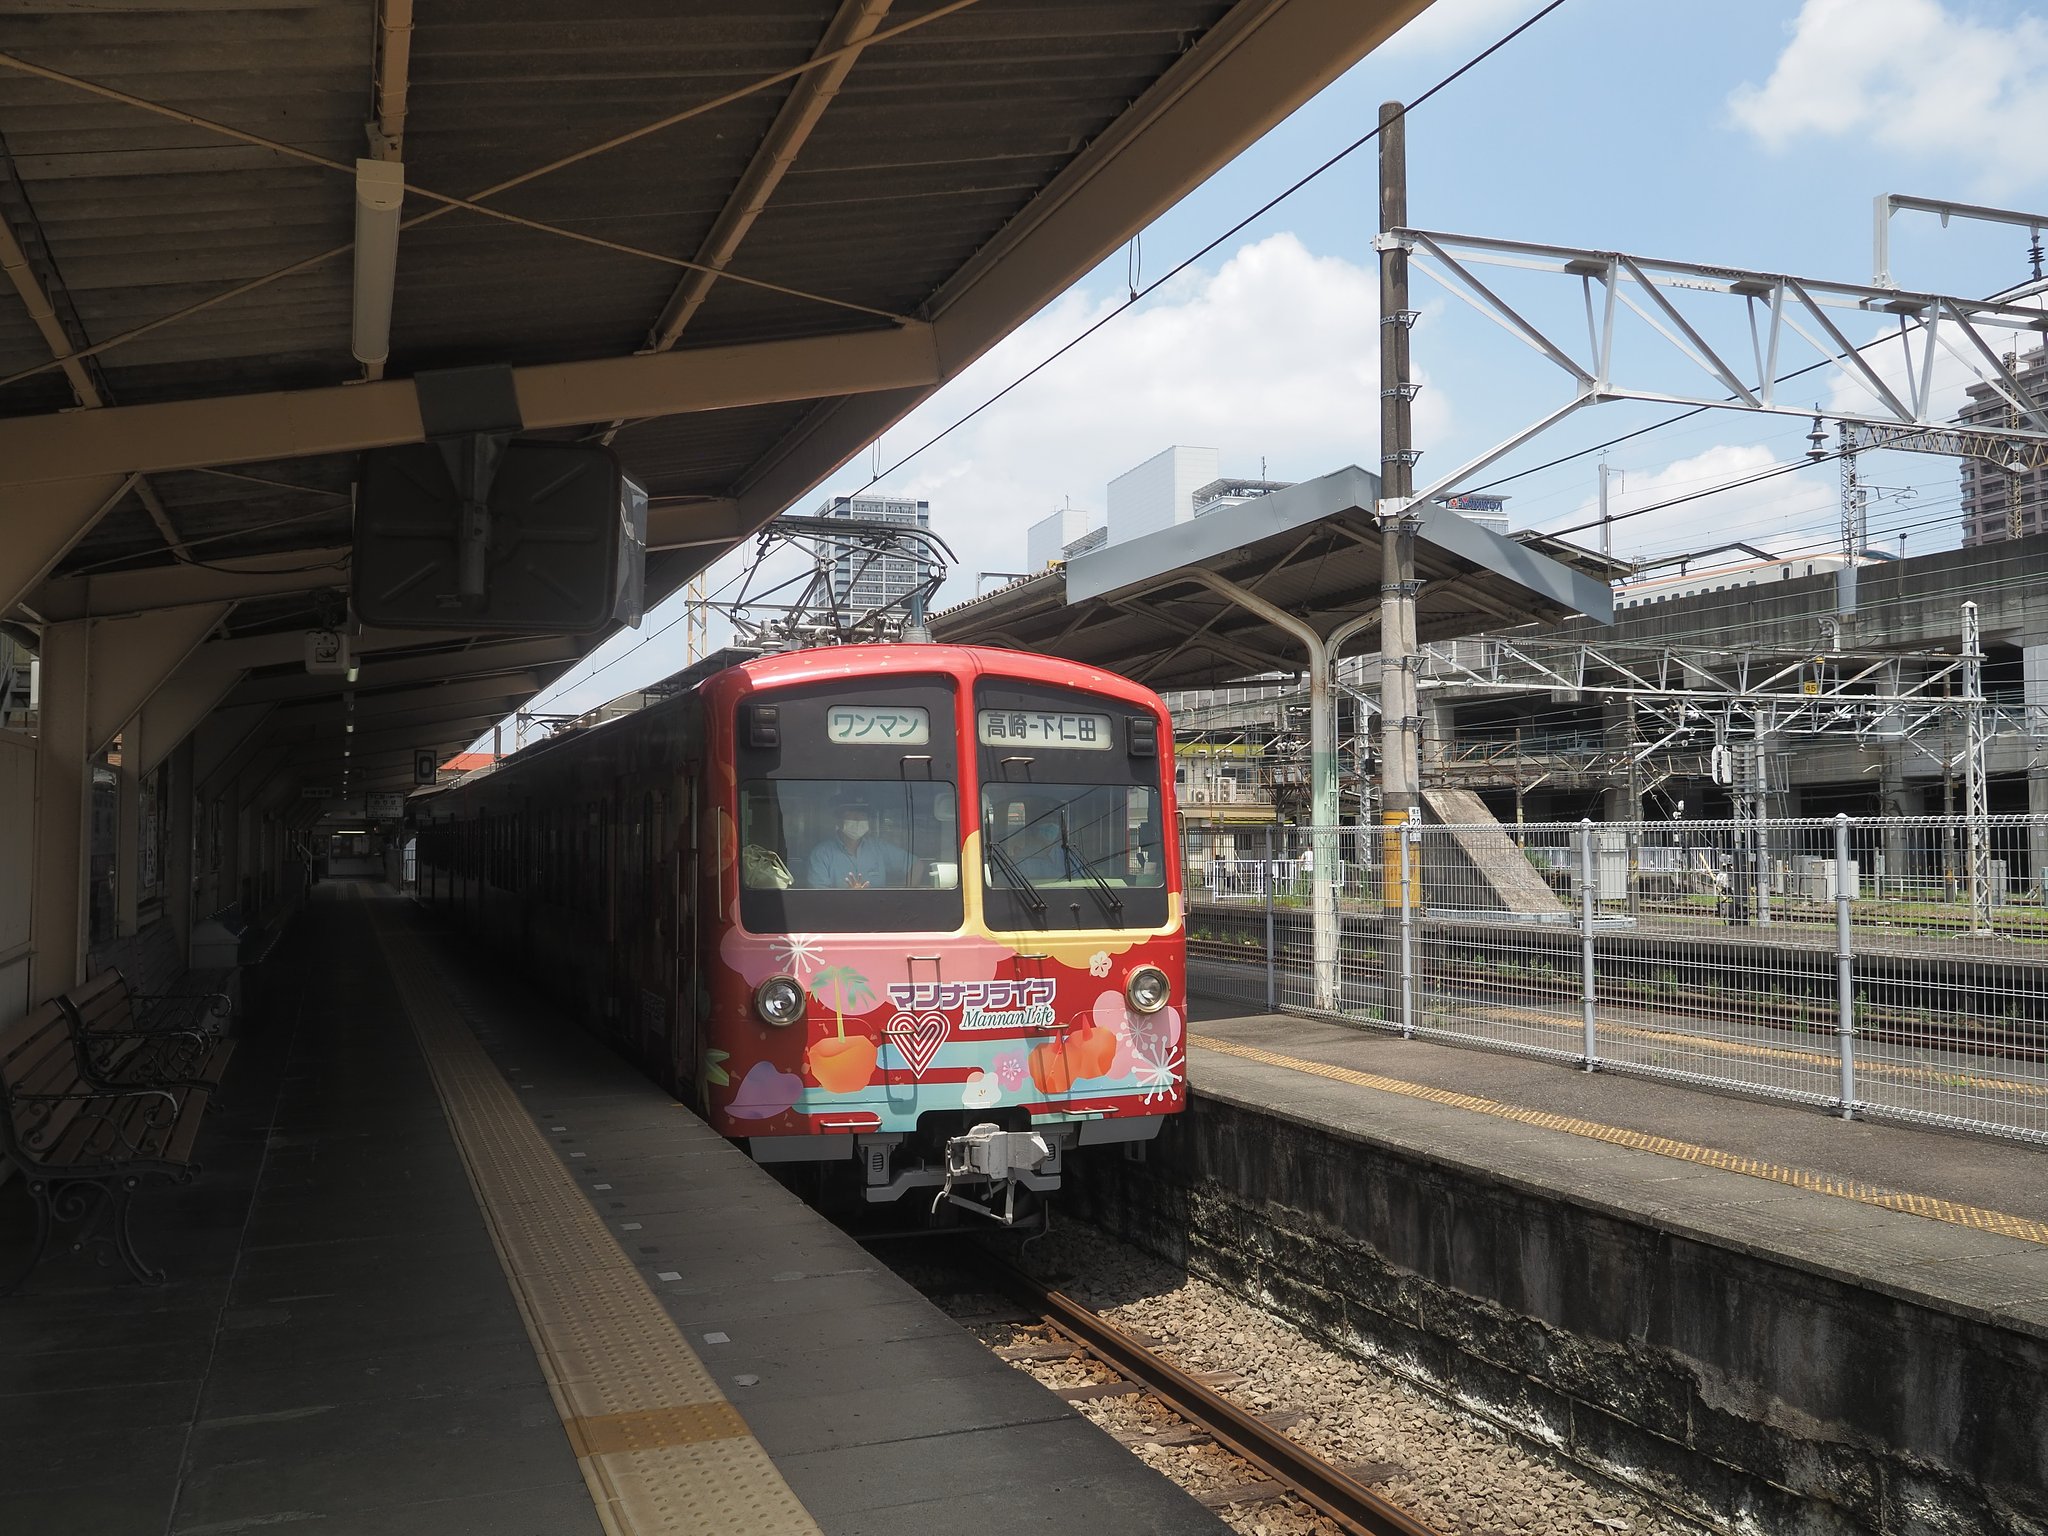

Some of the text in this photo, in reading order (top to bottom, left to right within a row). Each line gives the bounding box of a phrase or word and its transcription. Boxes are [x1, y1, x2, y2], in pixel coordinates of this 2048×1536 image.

[834, 713, 918, 738] ワンマン
[889, 980, 1055, 1009] マンナンライフ
